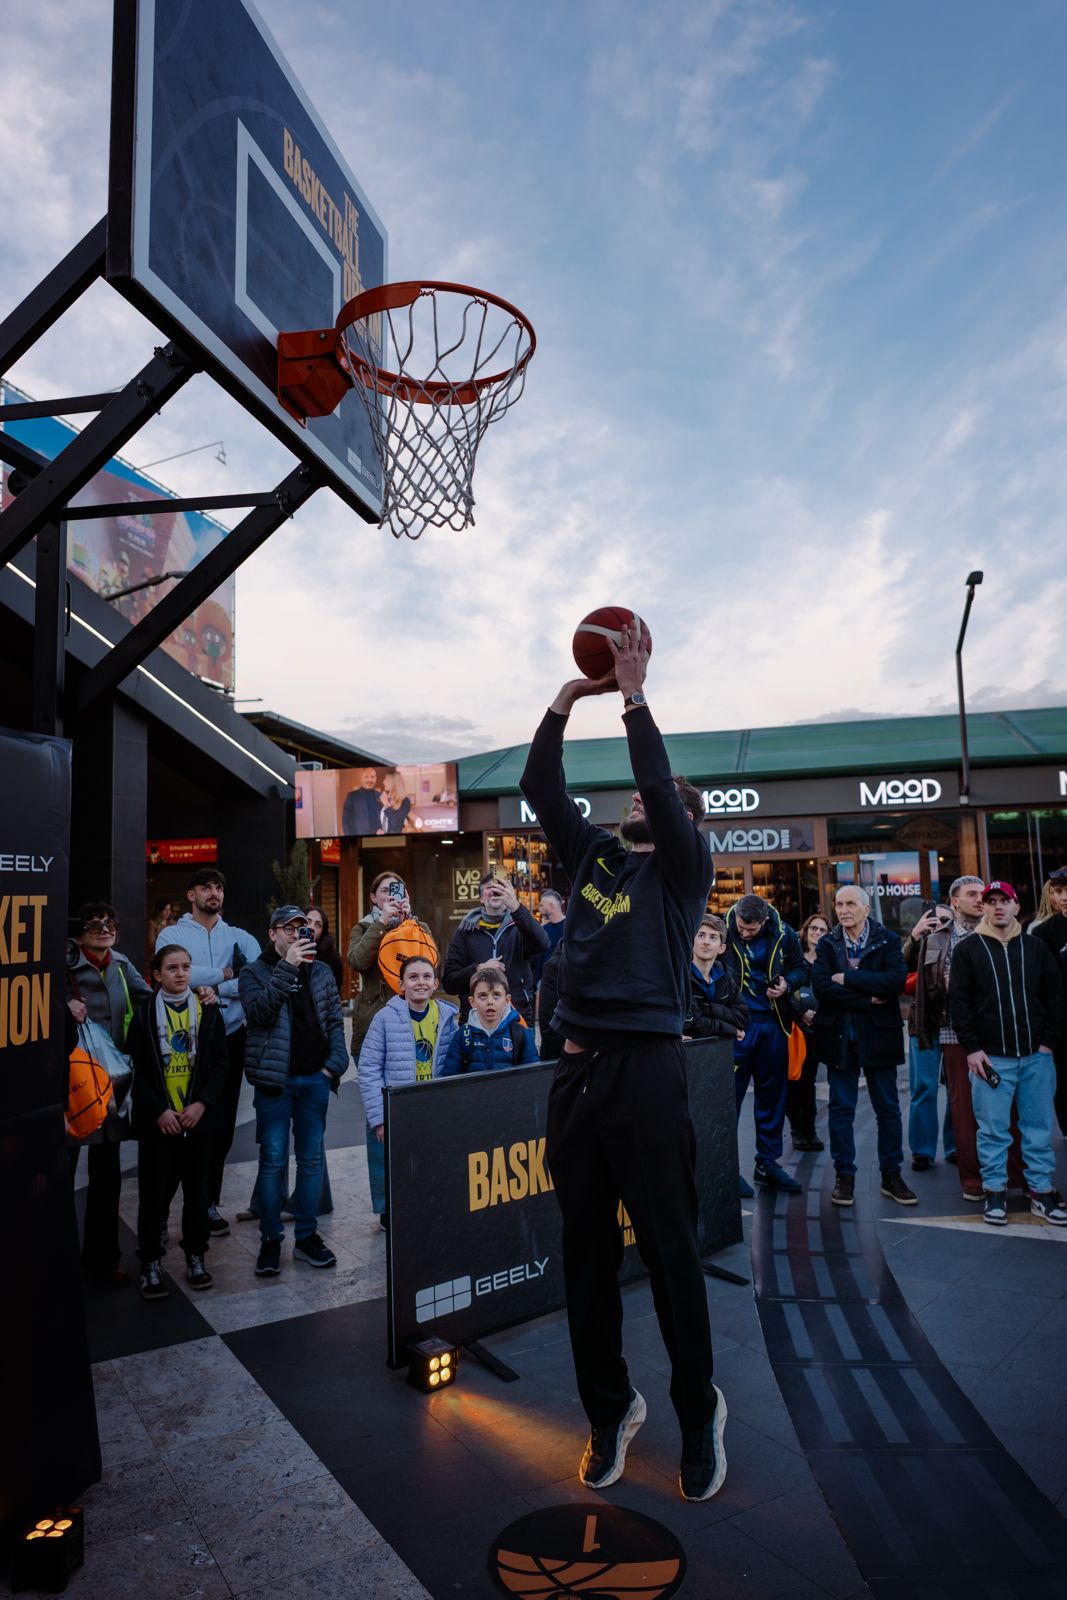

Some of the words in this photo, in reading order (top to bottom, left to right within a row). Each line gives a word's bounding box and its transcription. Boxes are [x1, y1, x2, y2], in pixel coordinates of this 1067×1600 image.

[283, 126, 362, 281] BASKETBALL
[859, 778, 942, 806] MOOD
[520, 797, 591, 822] MD
[709, 829, 780, 852] MOOD
[886, 884, 921, 896] HOUSE
[468, 1137, 555, 1213] BASK
[475, 1257, 549, 1296] GEELY
